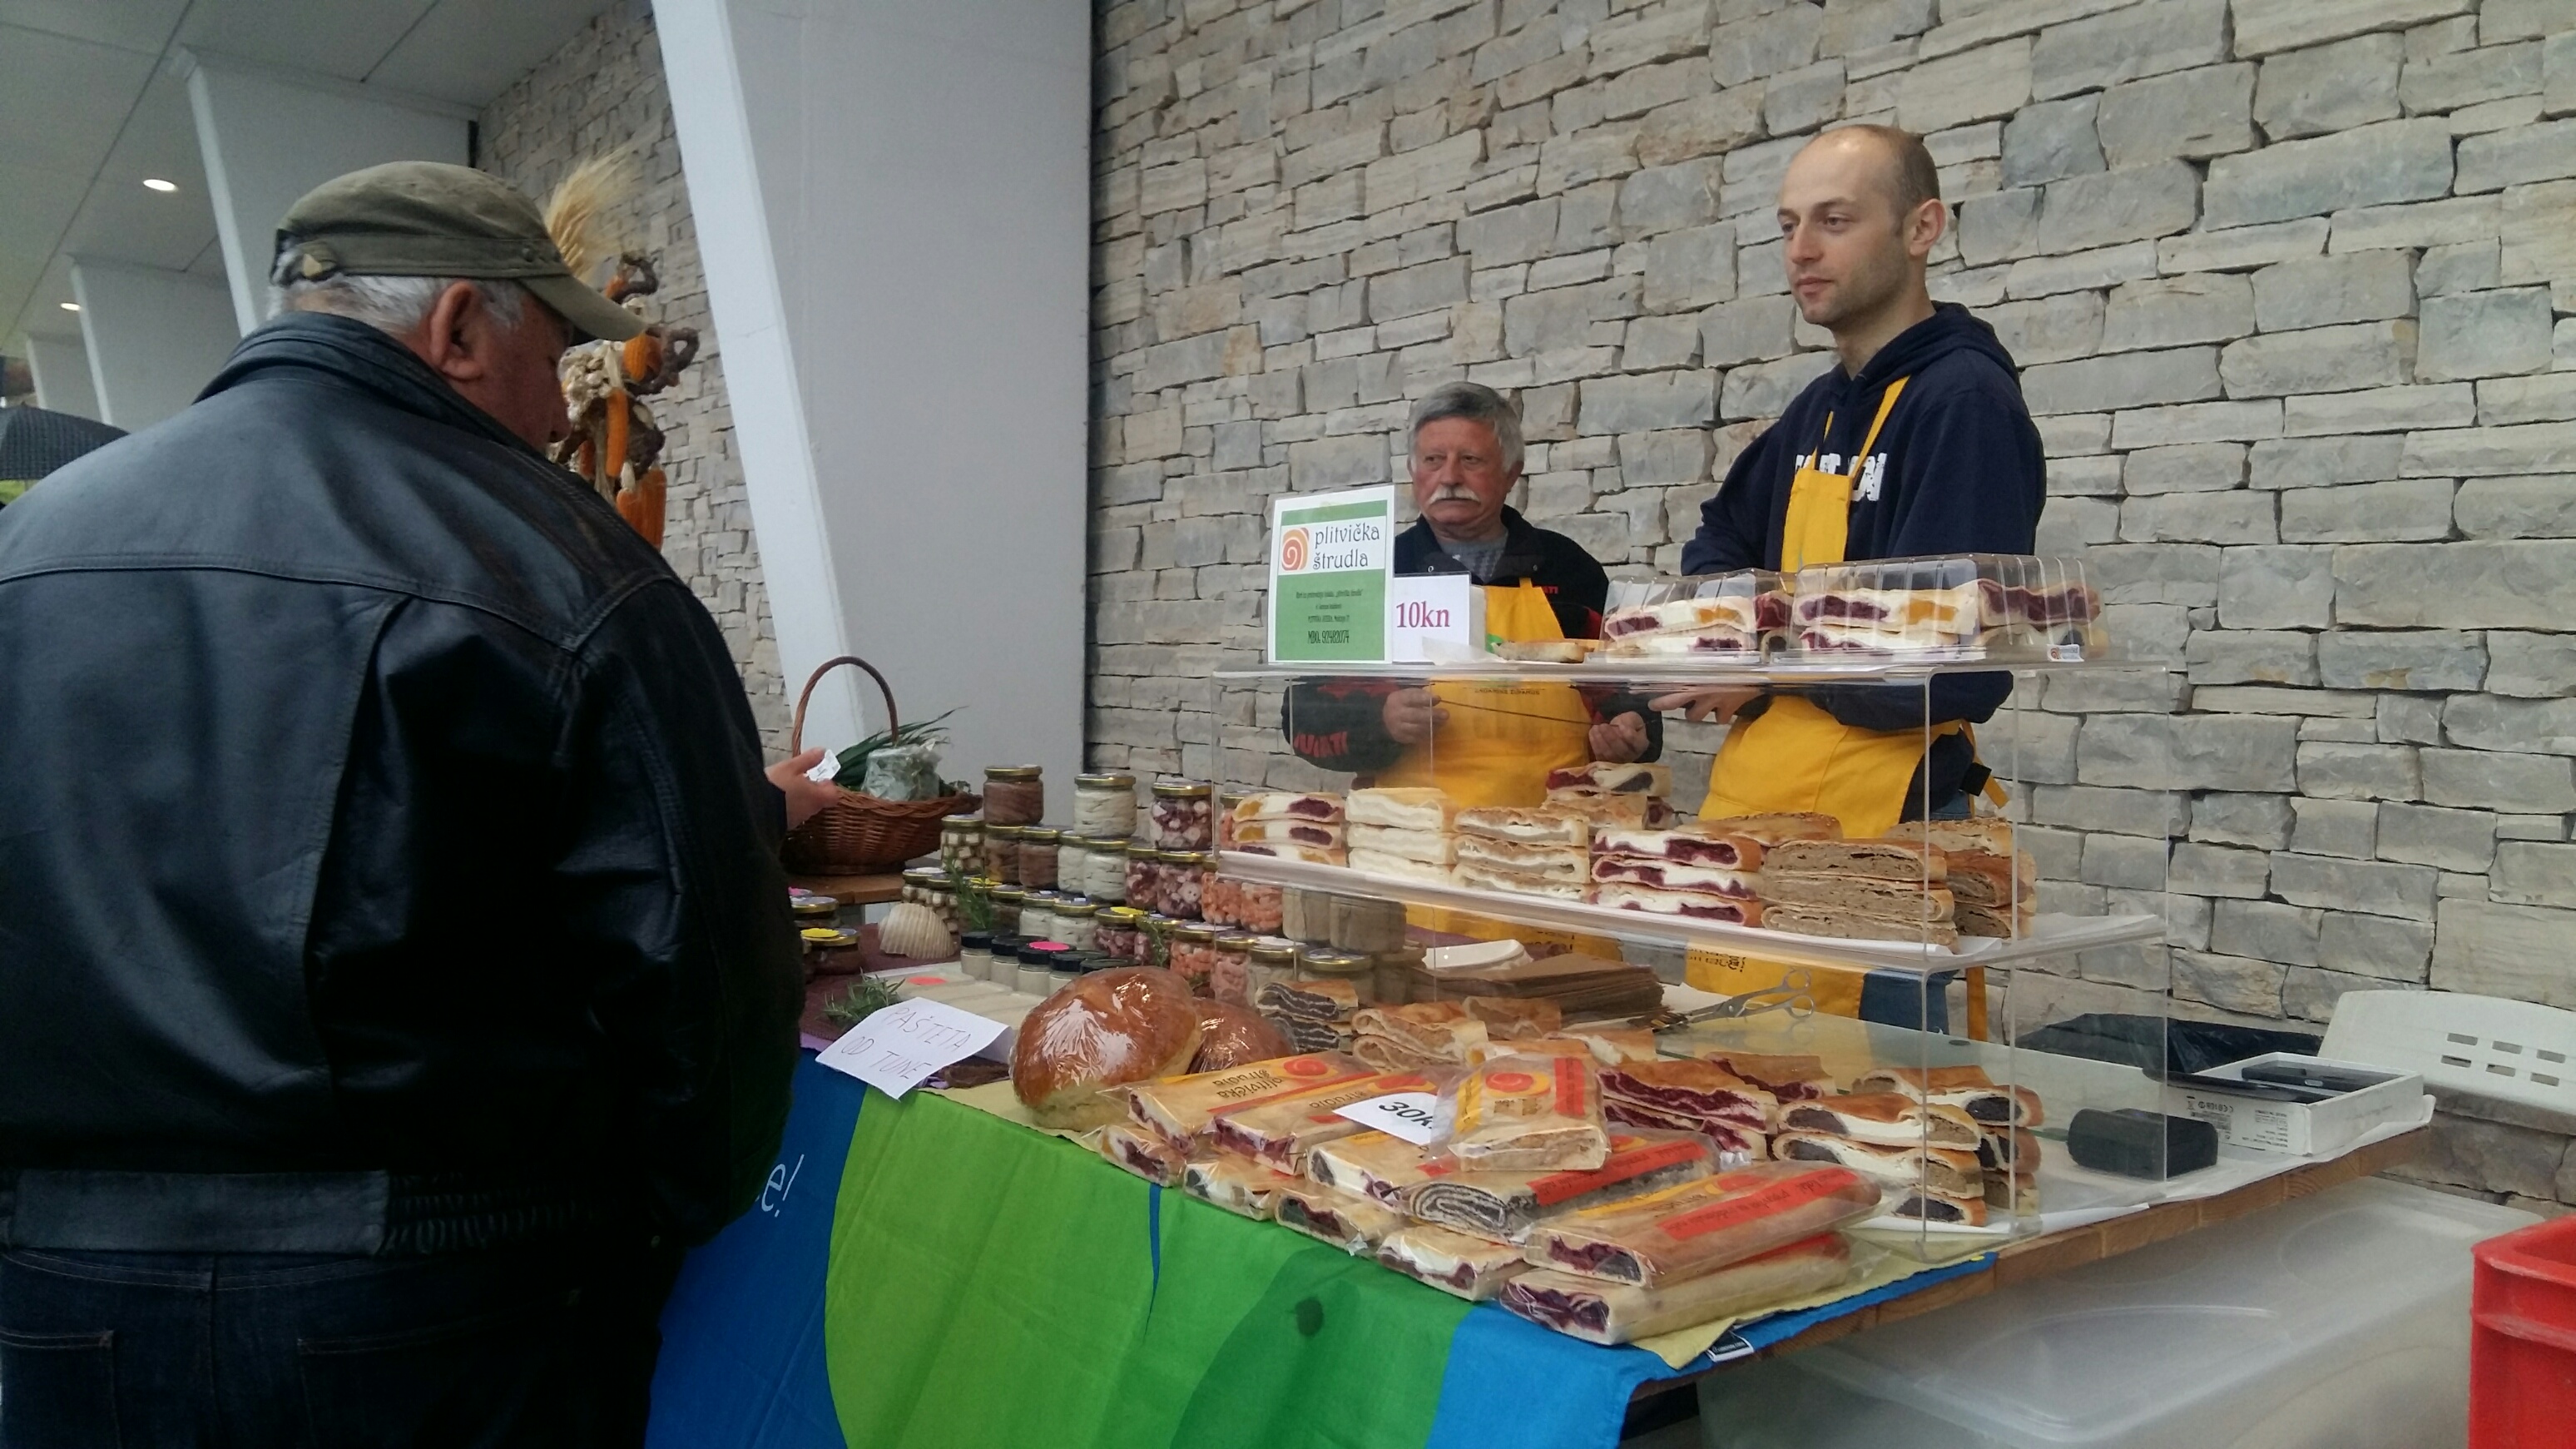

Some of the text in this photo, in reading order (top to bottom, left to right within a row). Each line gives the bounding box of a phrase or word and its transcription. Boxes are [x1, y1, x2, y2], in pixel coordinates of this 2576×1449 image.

[1315, 522, 1380, 549] plitvička
[1312, 548, 1369, 570] štrudla
[1395, 601, 1450, 628] 10kn
[883, 1007, 972, 1052] PAŠTETA
[841, 1036, 932, 1079] OD TUNE
[1378, 1101, 1434, 1129] 30k
